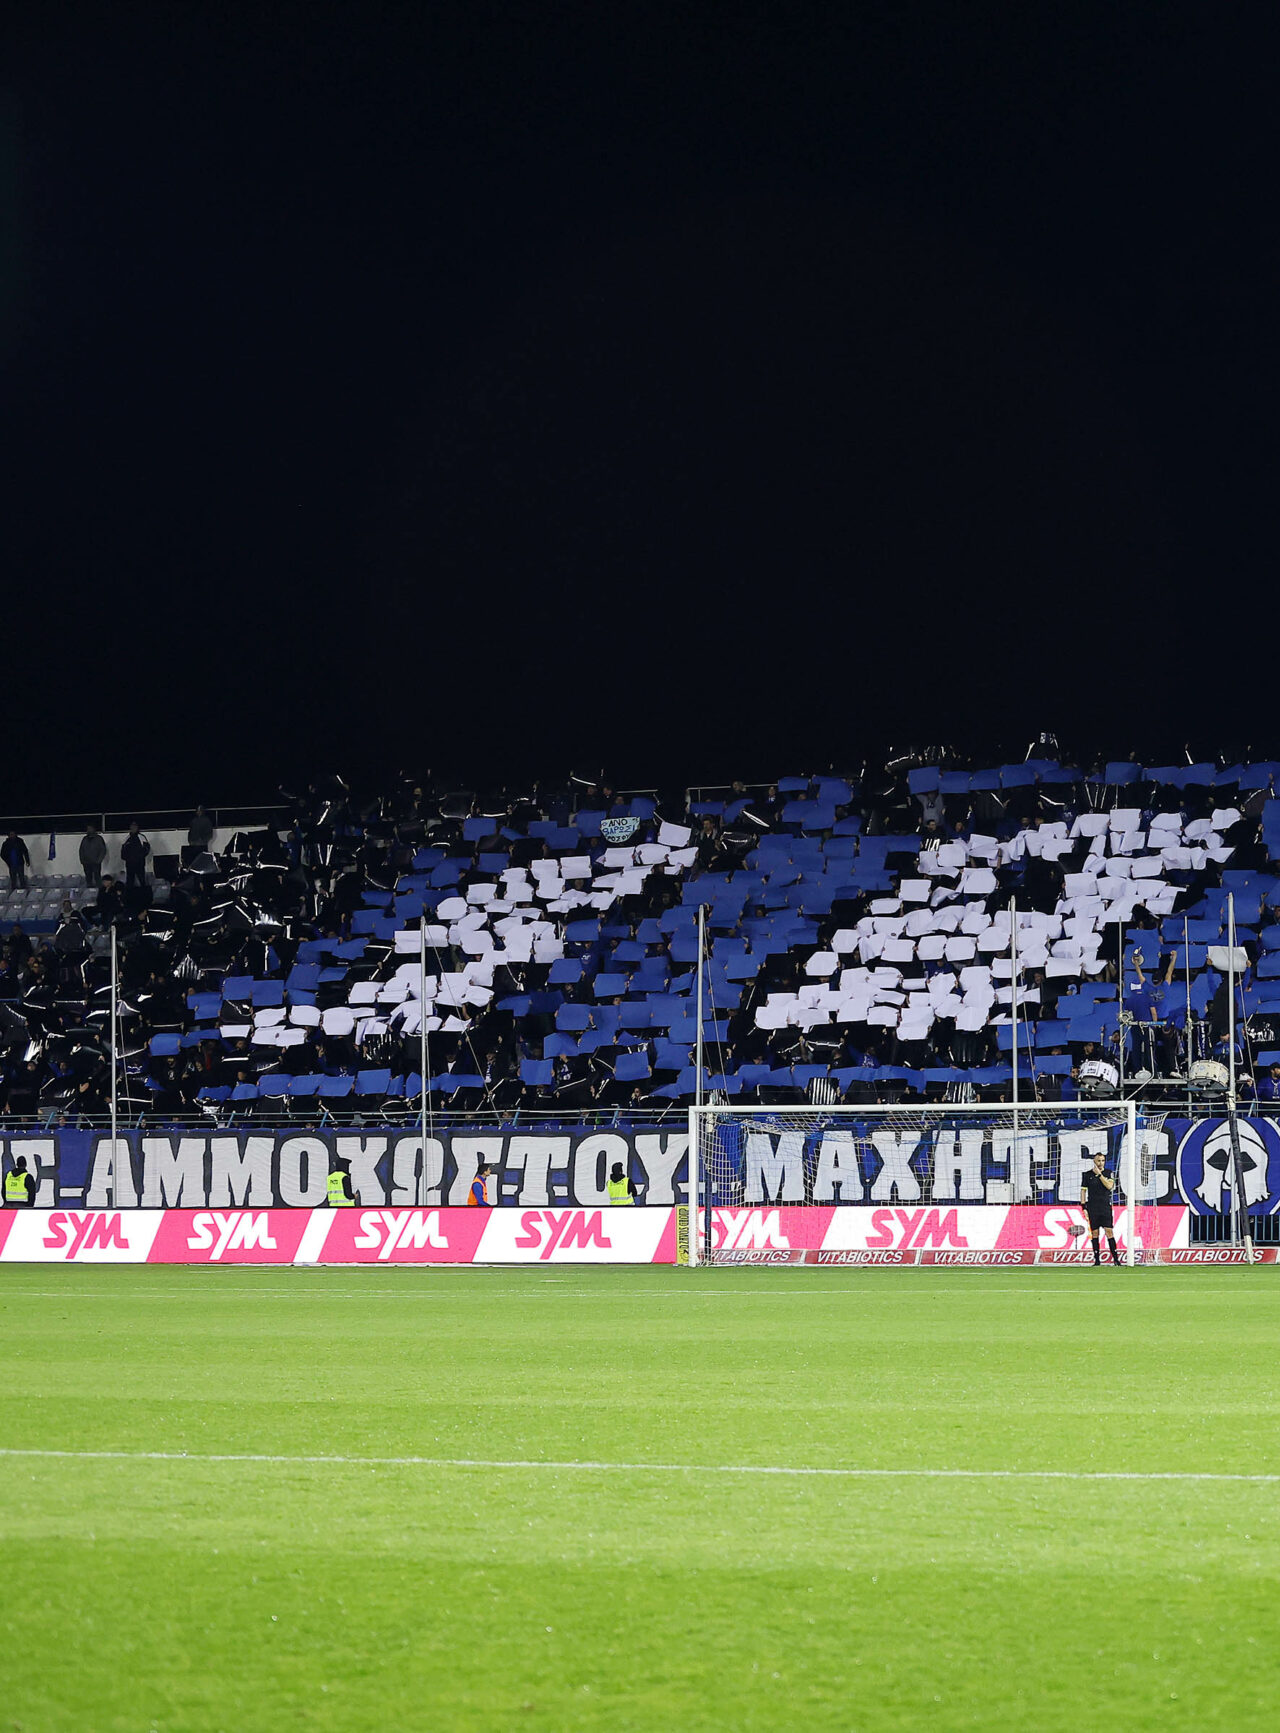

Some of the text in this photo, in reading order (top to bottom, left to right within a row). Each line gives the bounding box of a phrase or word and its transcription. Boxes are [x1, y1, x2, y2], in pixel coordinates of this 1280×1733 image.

[42, 1212, 129, 1259] SYM
[186, 1212, 277, 1260] SYM
[354, 1211, 449, 1259] SYM
[515, 1211, 612, 1260] SYM
[865, 1208, 969, 1249] SYM
[817, 1251, 904, 1263] VITABIOTICS
[934, 1251, 1023, 1263] VITABIOTICS
